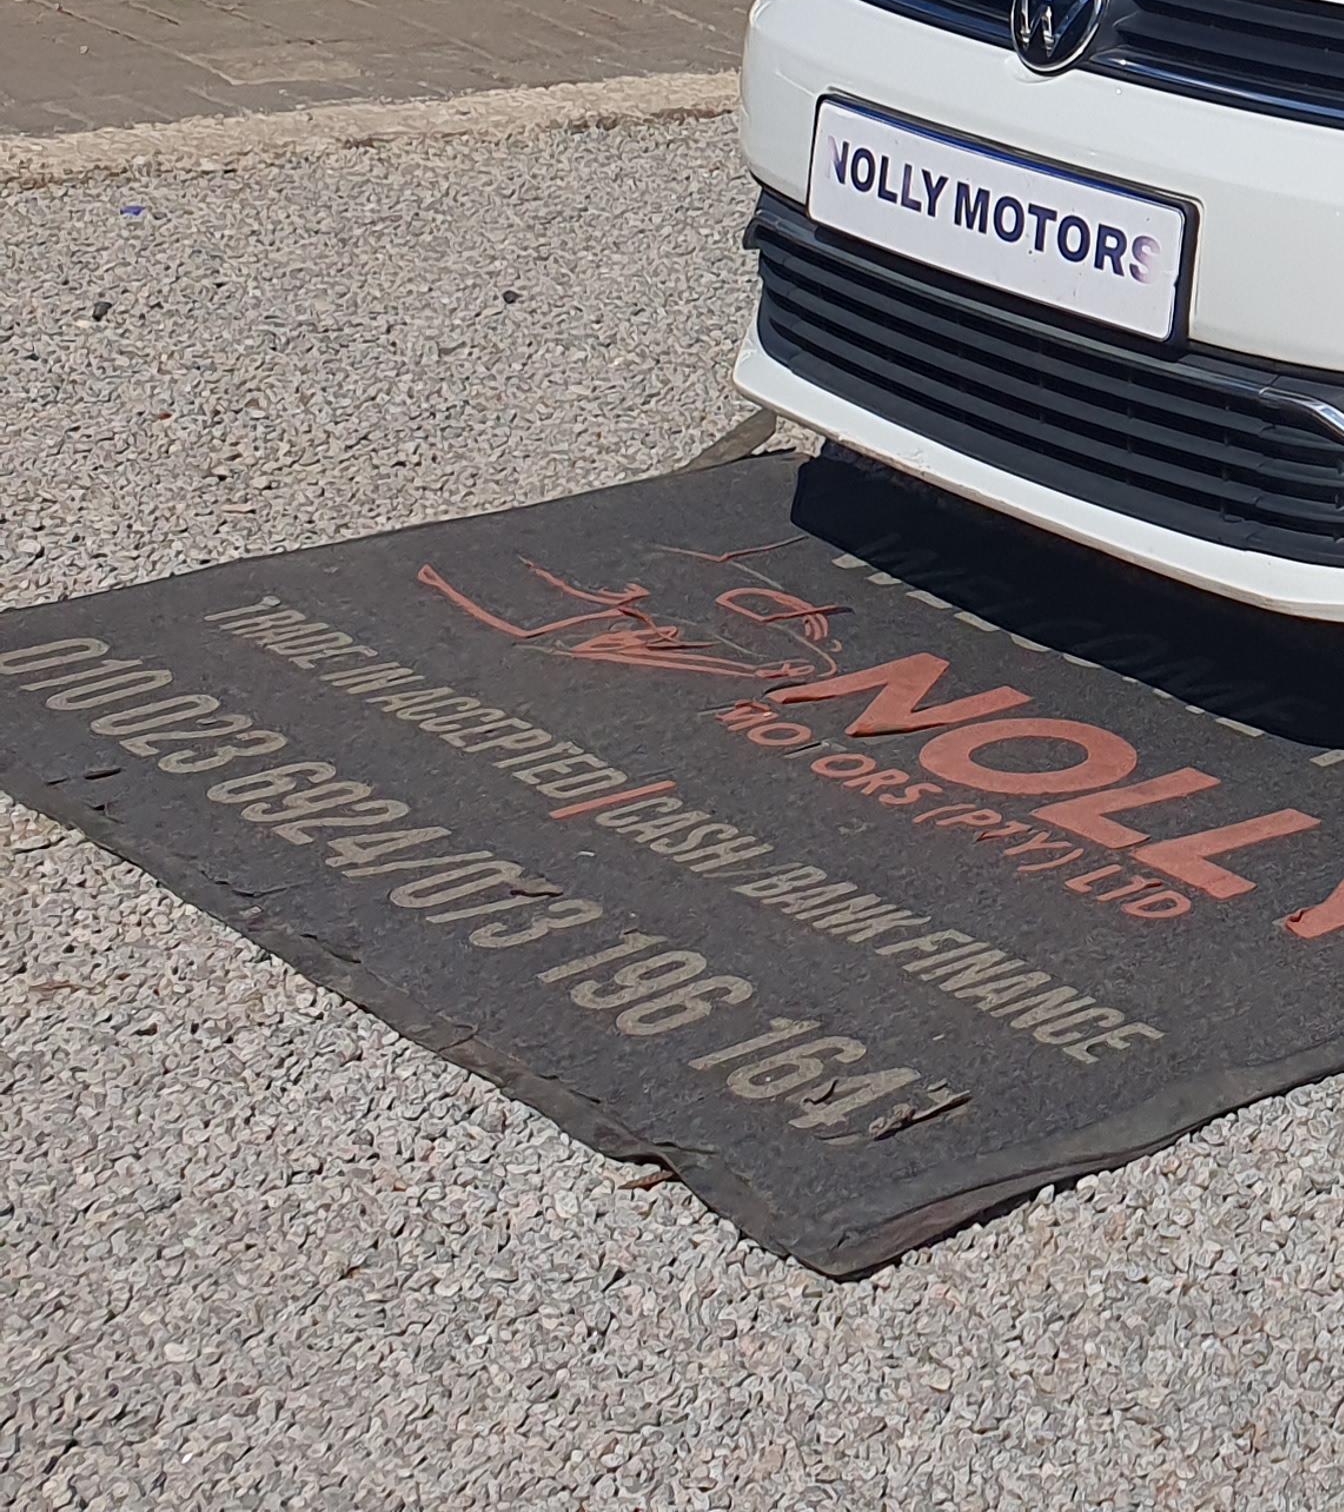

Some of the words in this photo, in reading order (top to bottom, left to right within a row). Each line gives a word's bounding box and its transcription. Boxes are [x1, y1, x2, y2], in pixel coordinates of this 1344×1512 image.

[826, 135, 949, 218] NOLLY
[954, 185, 1162, 284] MOTORS
[0, 637, 174, 710] 010
[90, 694, 288, 774] 023
[537, 929, 754, 1036] 196
[204, 595, 379, 669] TRADE
[319, 662, 425, 694] IN
[874, 929, 1165, 1064] FINANCE
[912, 803, 1084, 872] (PTY)
[1065, 864, 1192, 919] LTD
